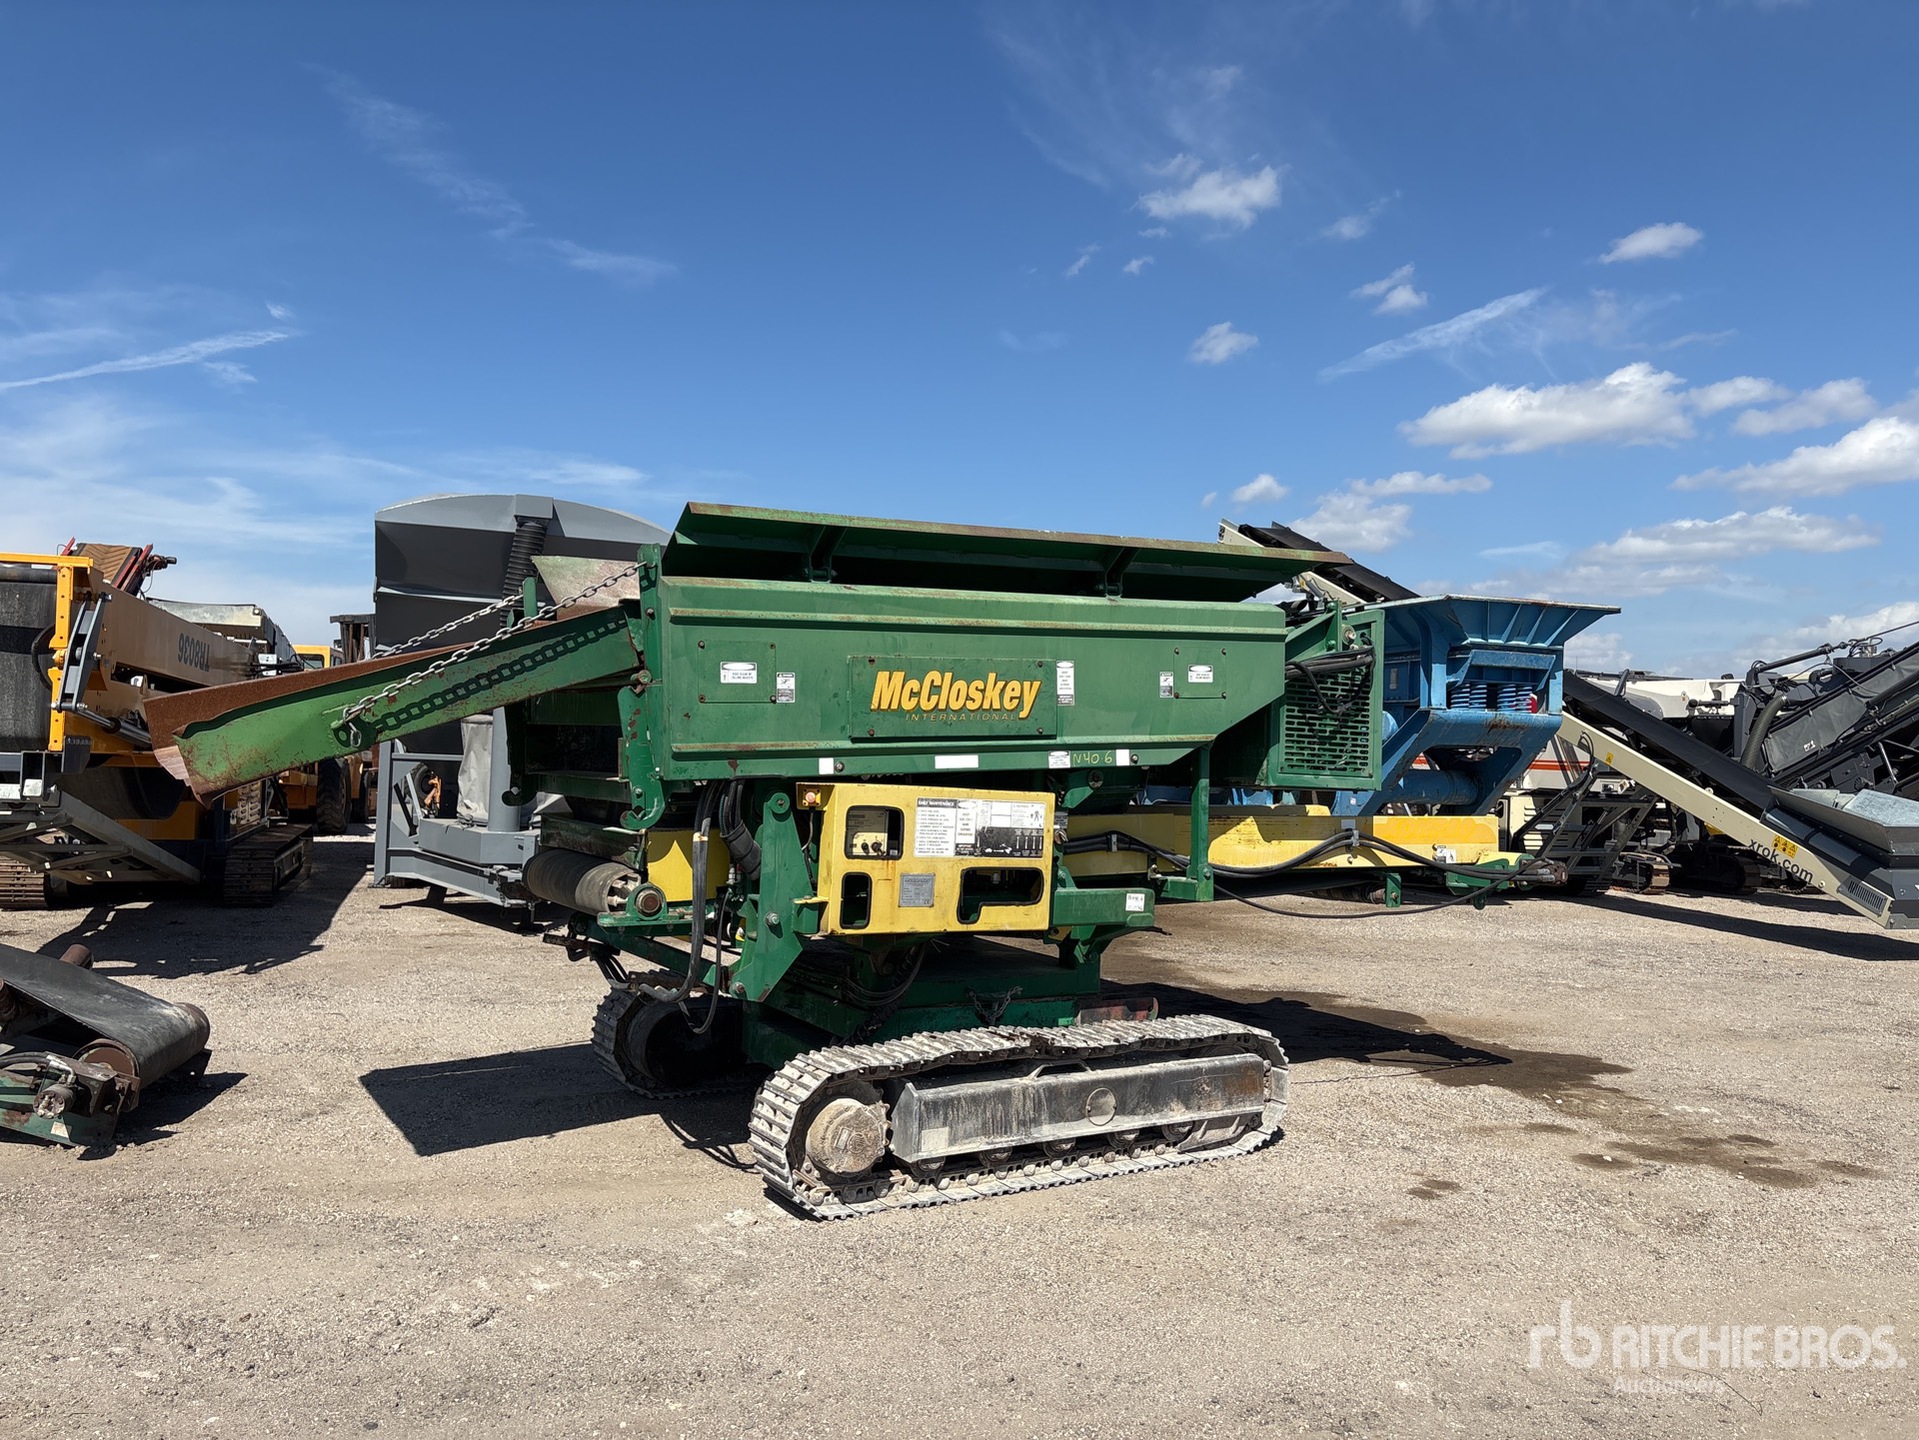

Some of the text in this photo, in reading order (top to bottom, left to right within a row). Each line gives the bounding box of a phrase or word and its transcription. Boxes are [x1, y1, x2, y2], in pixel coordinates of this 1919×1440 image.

[178, 633, 210, 672] TR8036
[870, 670, 1042, 720] McCloskey
[905, 713, 1018, 722] INTERNATIONAL
[1749, 839, 1813, 884] xrok.com
